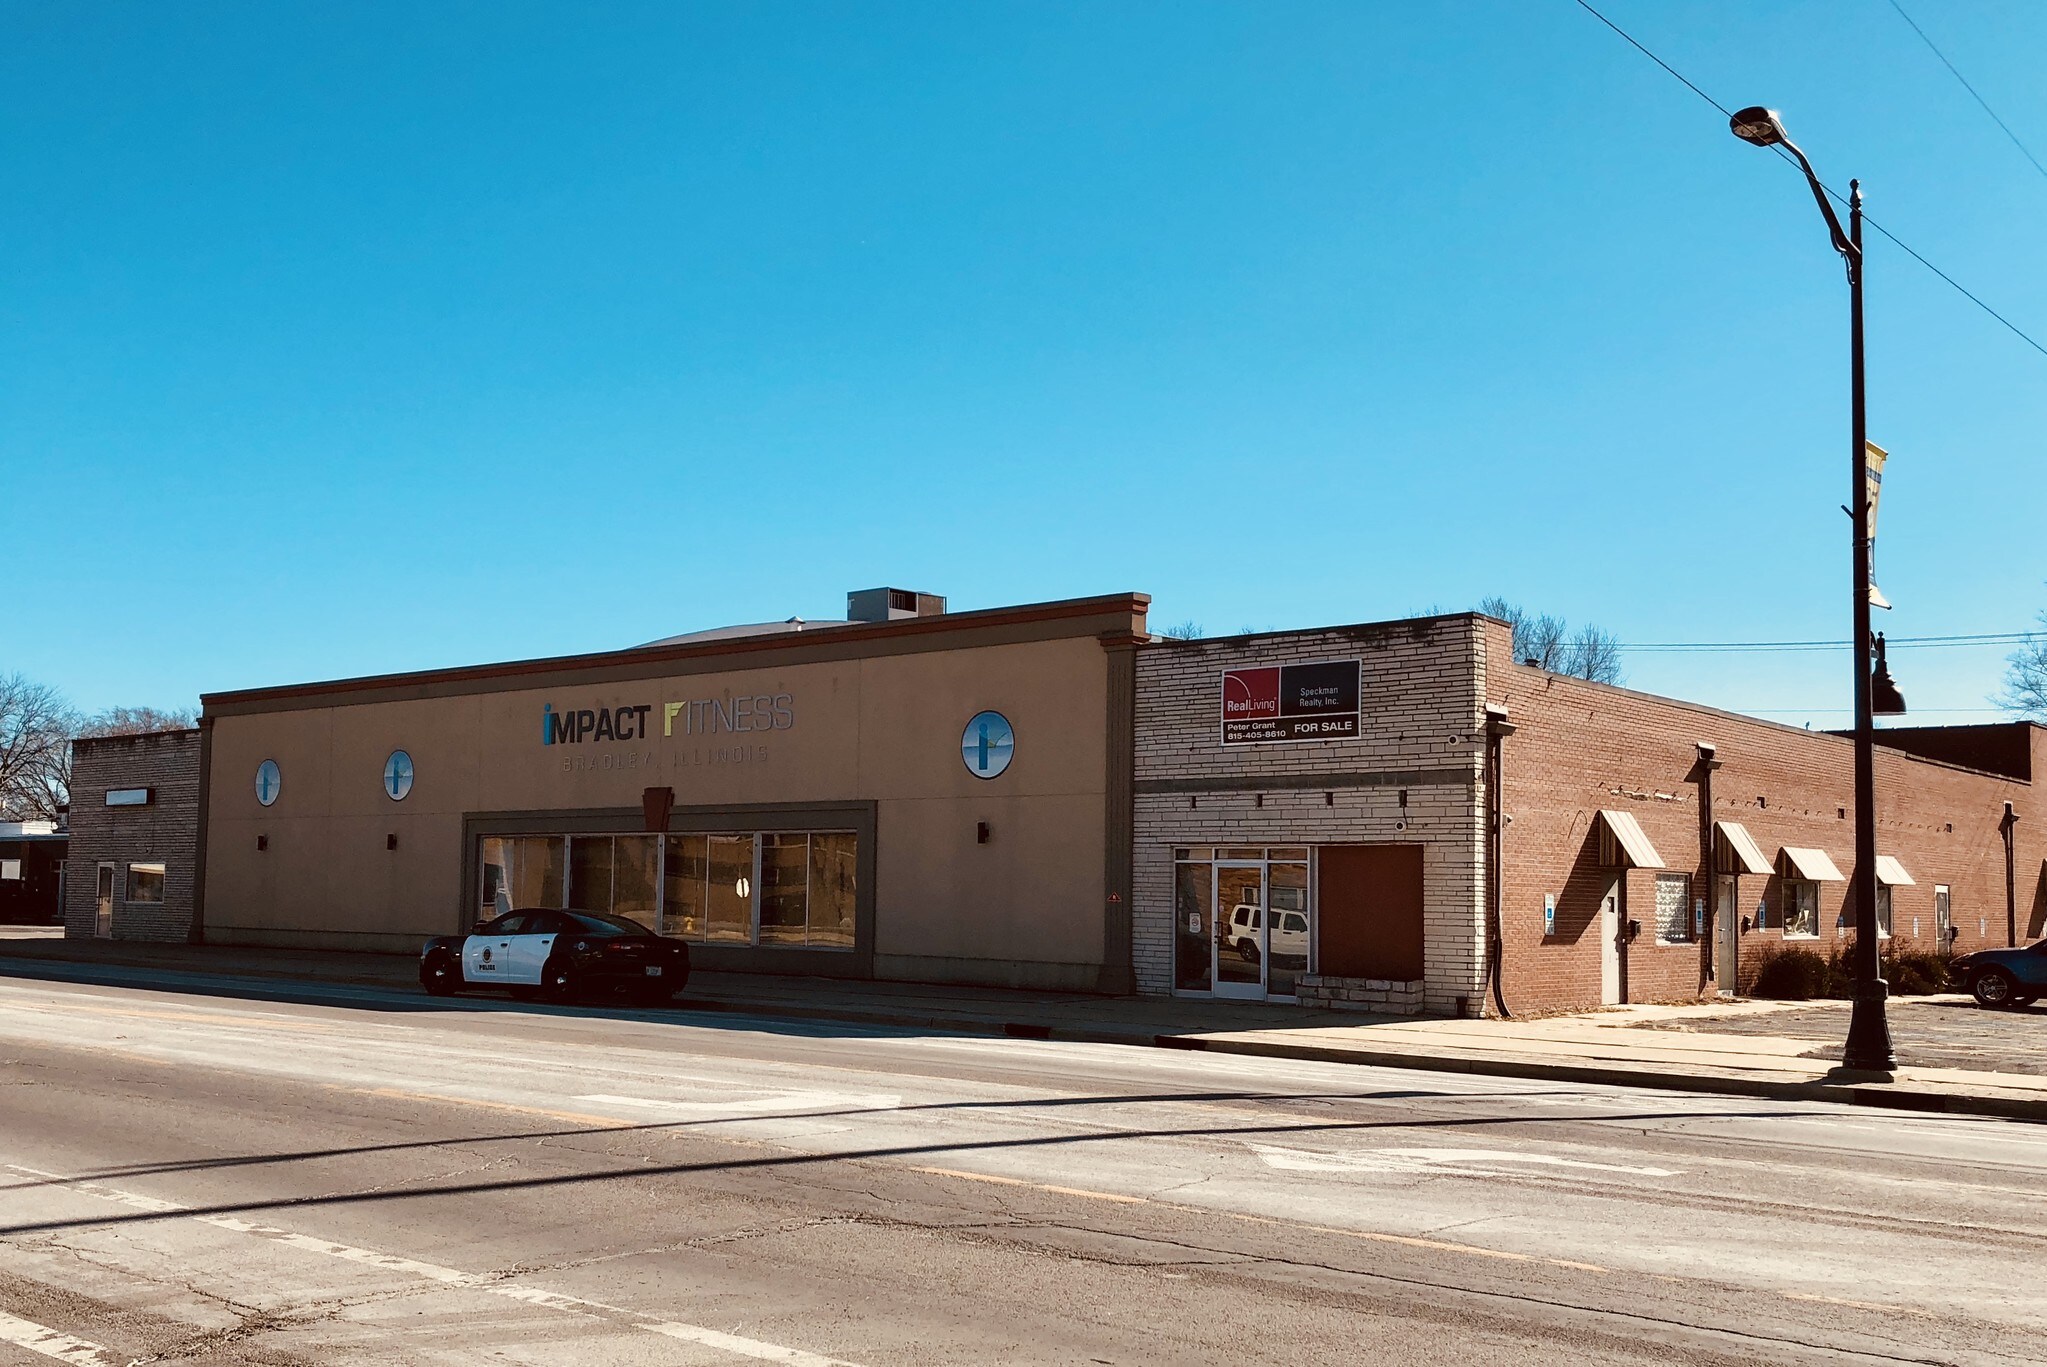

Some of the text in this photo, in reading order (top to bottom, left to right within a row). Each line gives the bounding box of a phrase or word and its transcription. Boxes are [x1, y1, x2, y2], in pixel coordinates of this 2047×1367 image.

[1300, 687, 1338, 696] Speckman
[1325, 697, 1339, 705] Inc.
[664, 693, 793, 737] FITNESS
[1252, 722, 1276, 730] Grant
[1294, 721, 1352, 733] FOR SALE
[1227, 730, 1286, 740] 815-405-8610
[673, 745, 768, 767] ILLINOIS
